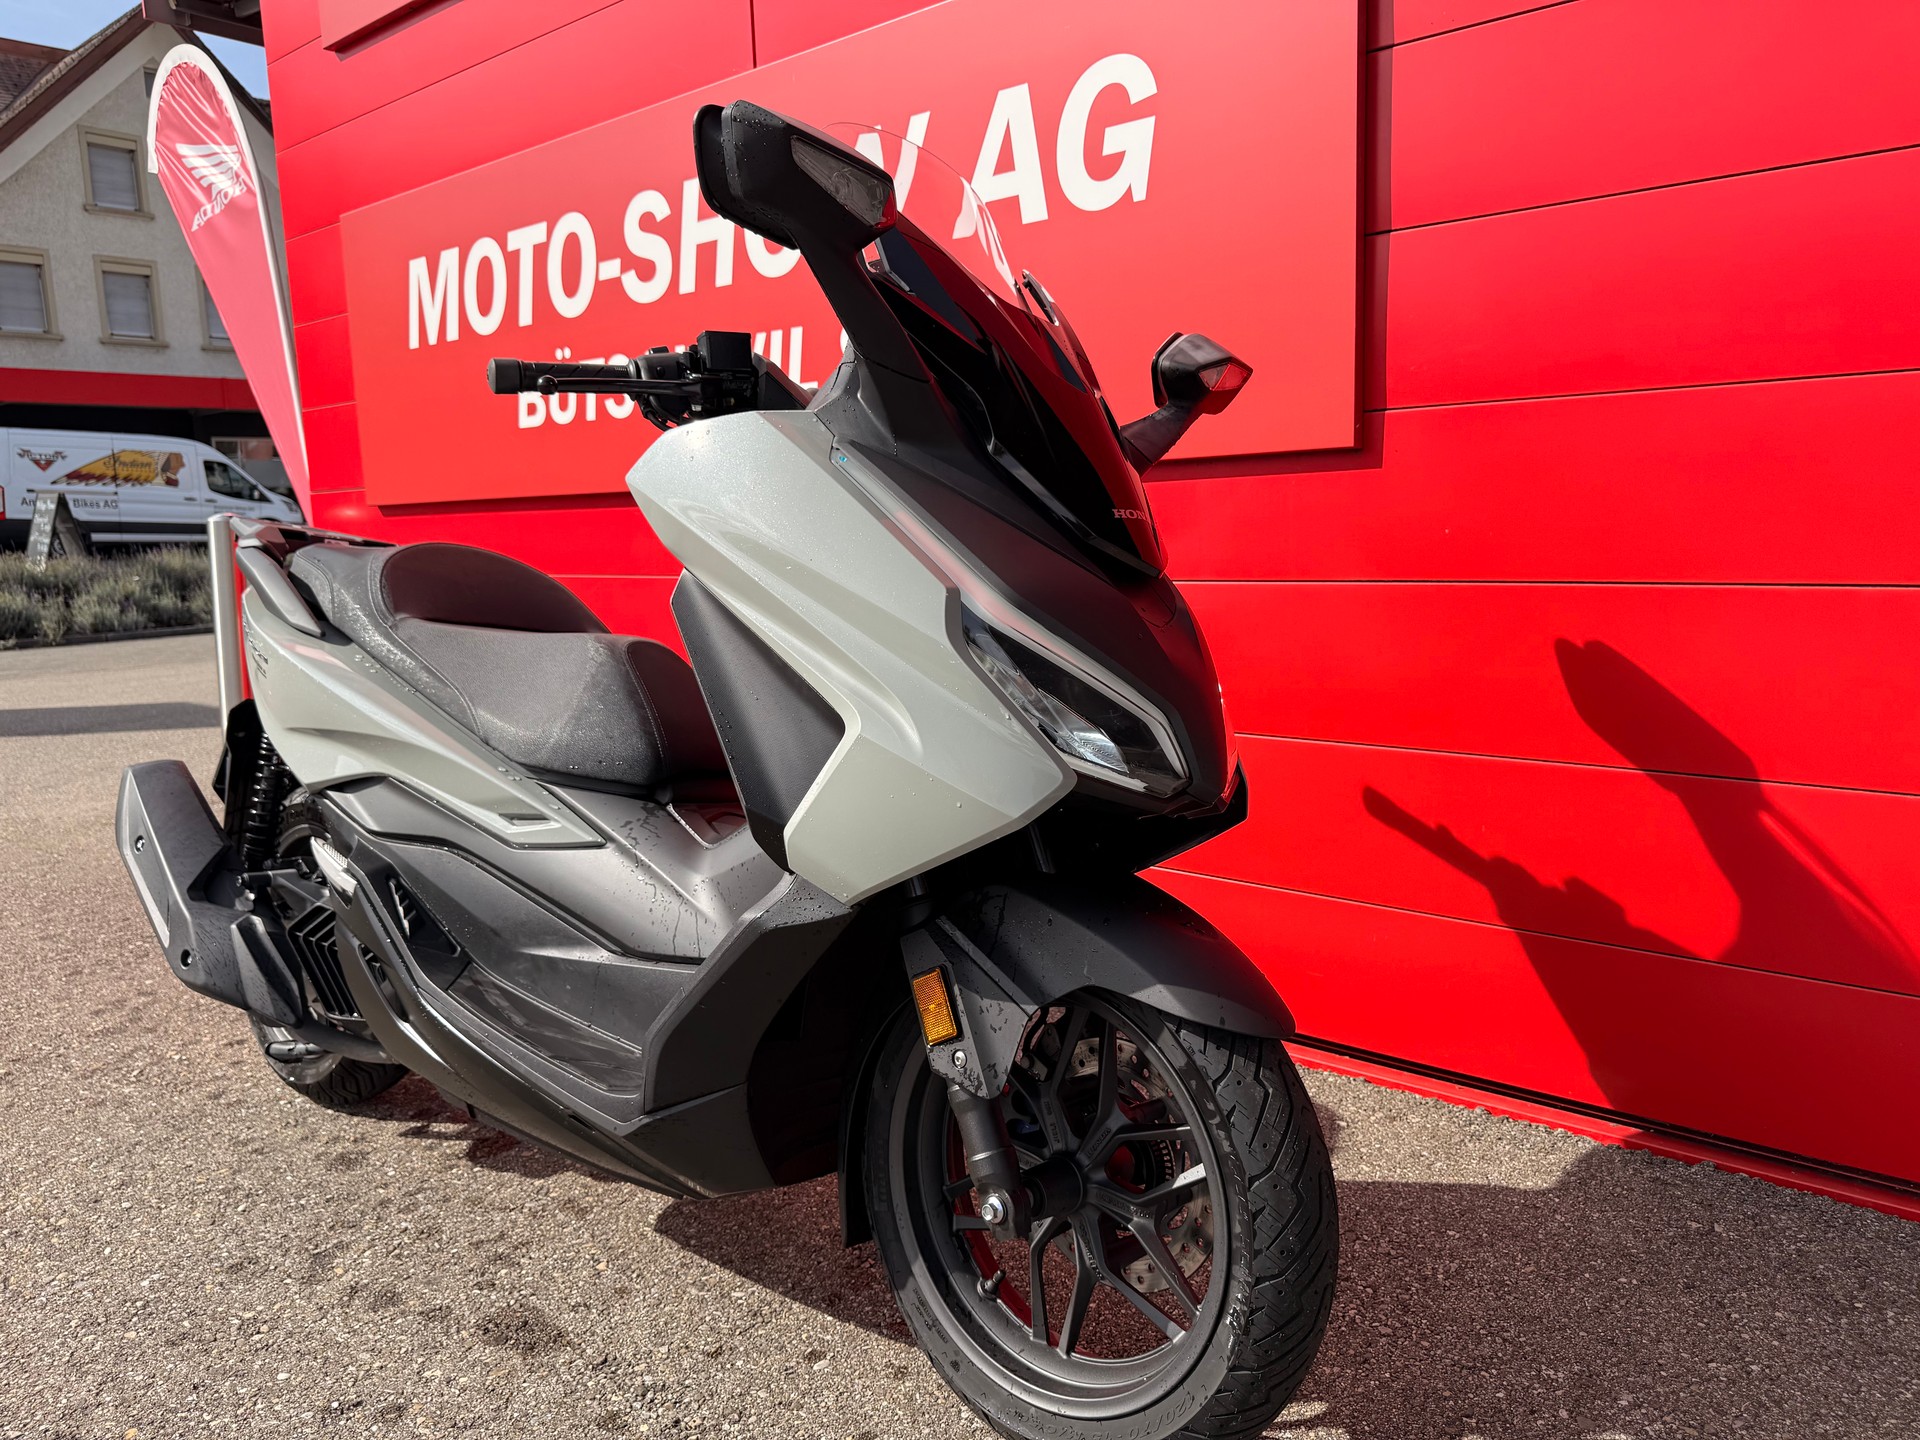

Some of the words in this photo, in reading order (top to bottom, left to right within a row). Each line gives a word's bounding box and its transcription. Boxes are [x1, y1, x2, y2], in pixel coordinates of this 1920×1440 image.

[952, 53, 1158, 240] AG
[73, 500, 100, 509] Bikes
[103, 500, 118, 509] AG
